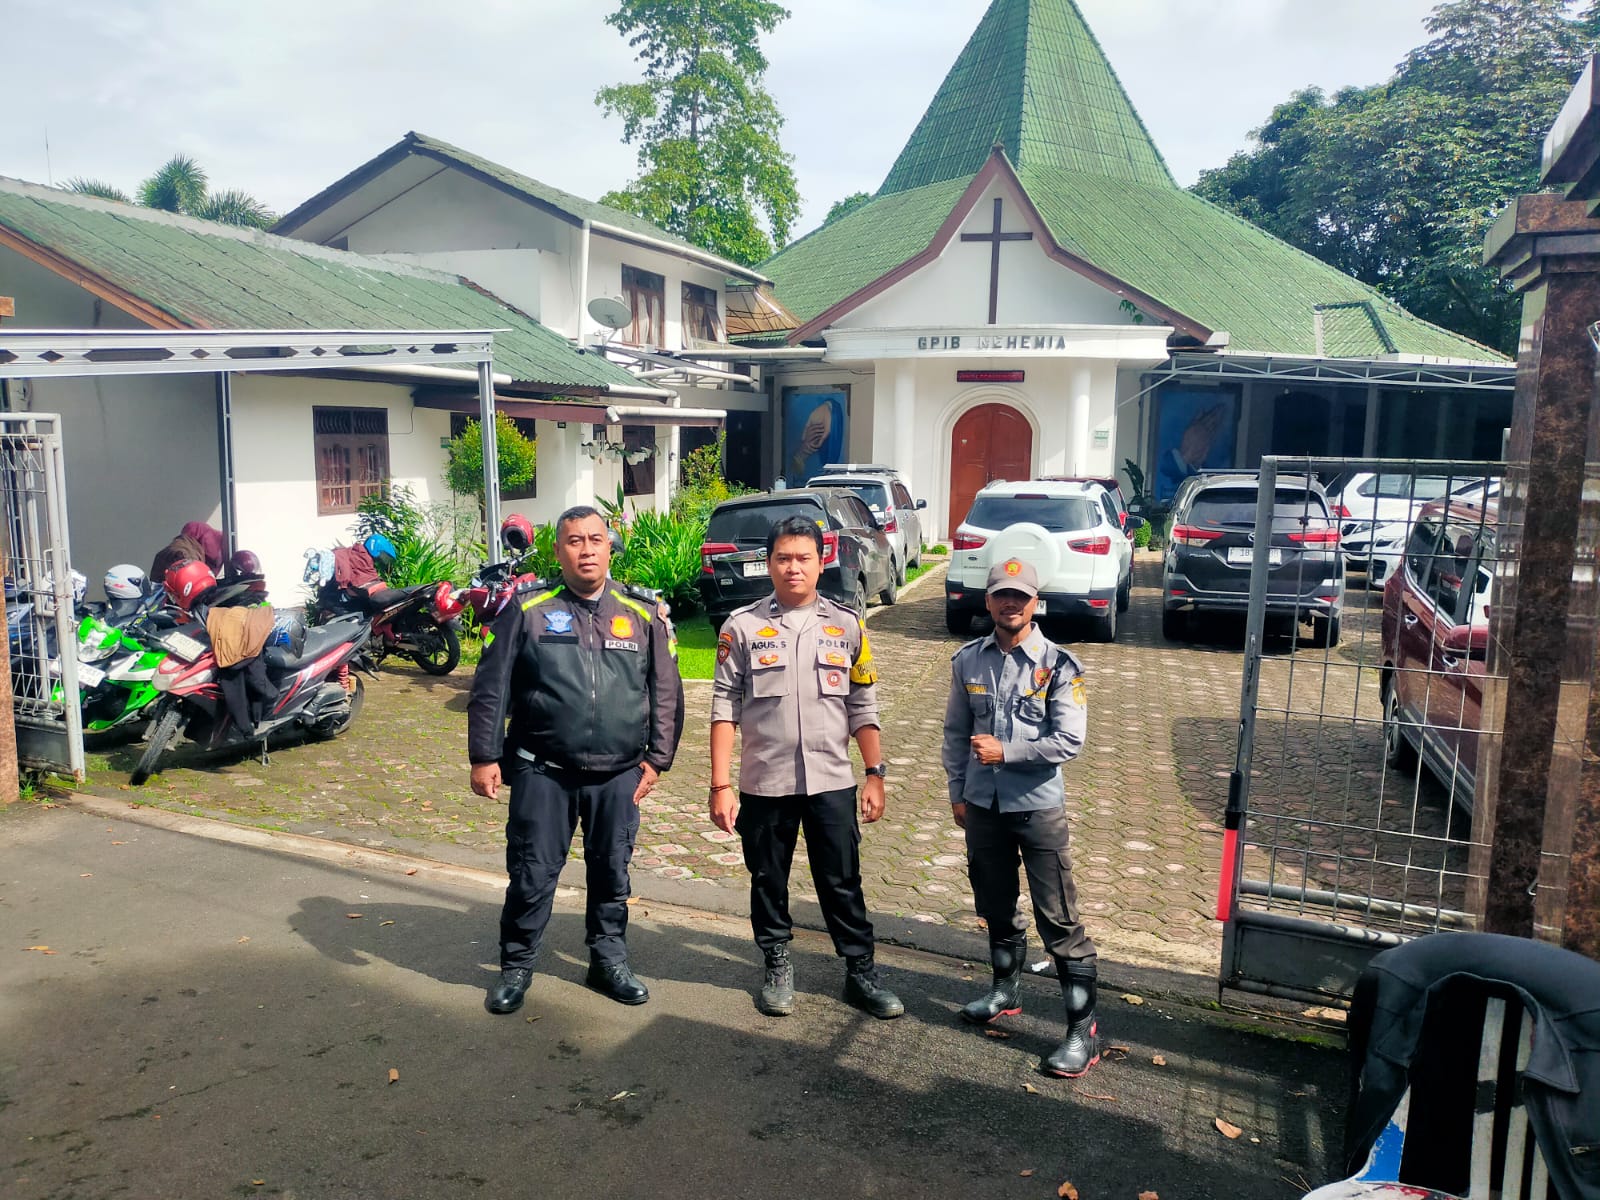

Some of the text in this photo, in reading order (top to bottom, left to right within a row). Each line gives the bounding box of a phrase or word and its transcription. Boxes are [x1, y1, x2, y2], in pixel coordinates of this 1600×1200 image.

[918, 335, 1066, 350] GPIB NEHEMIA
[608, 641, 637, 650] POLRI
[780, 640, 787, 649] S
[818, 638, 849, 650] POLRI
